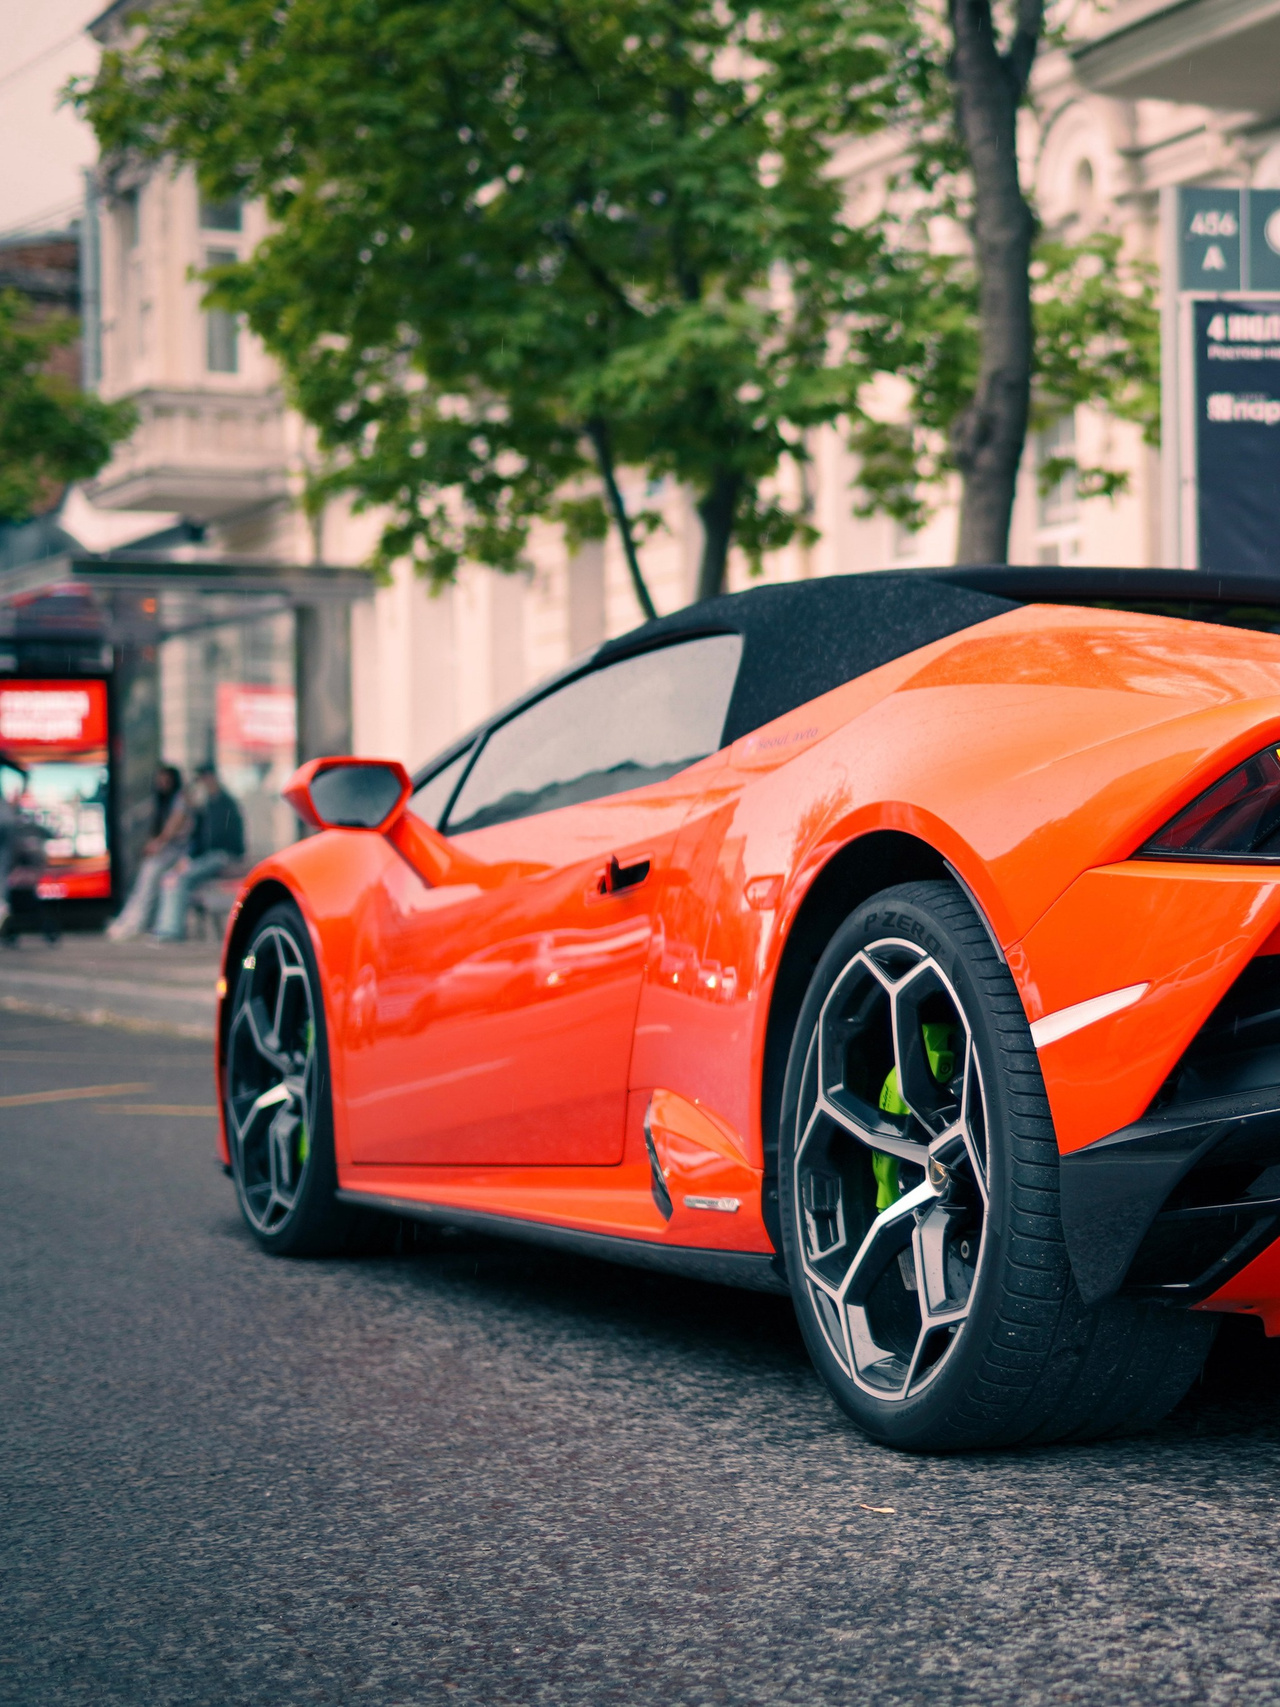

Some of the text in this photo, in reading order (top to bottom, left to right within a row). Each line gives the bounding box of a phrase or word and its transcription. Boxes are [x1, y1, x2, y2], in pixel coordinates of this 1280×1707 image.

[1190, 211, 1238, 237] 456
[1206, 313, 1226, 341] 4
[864, 911, 942, 956] P ZERO
